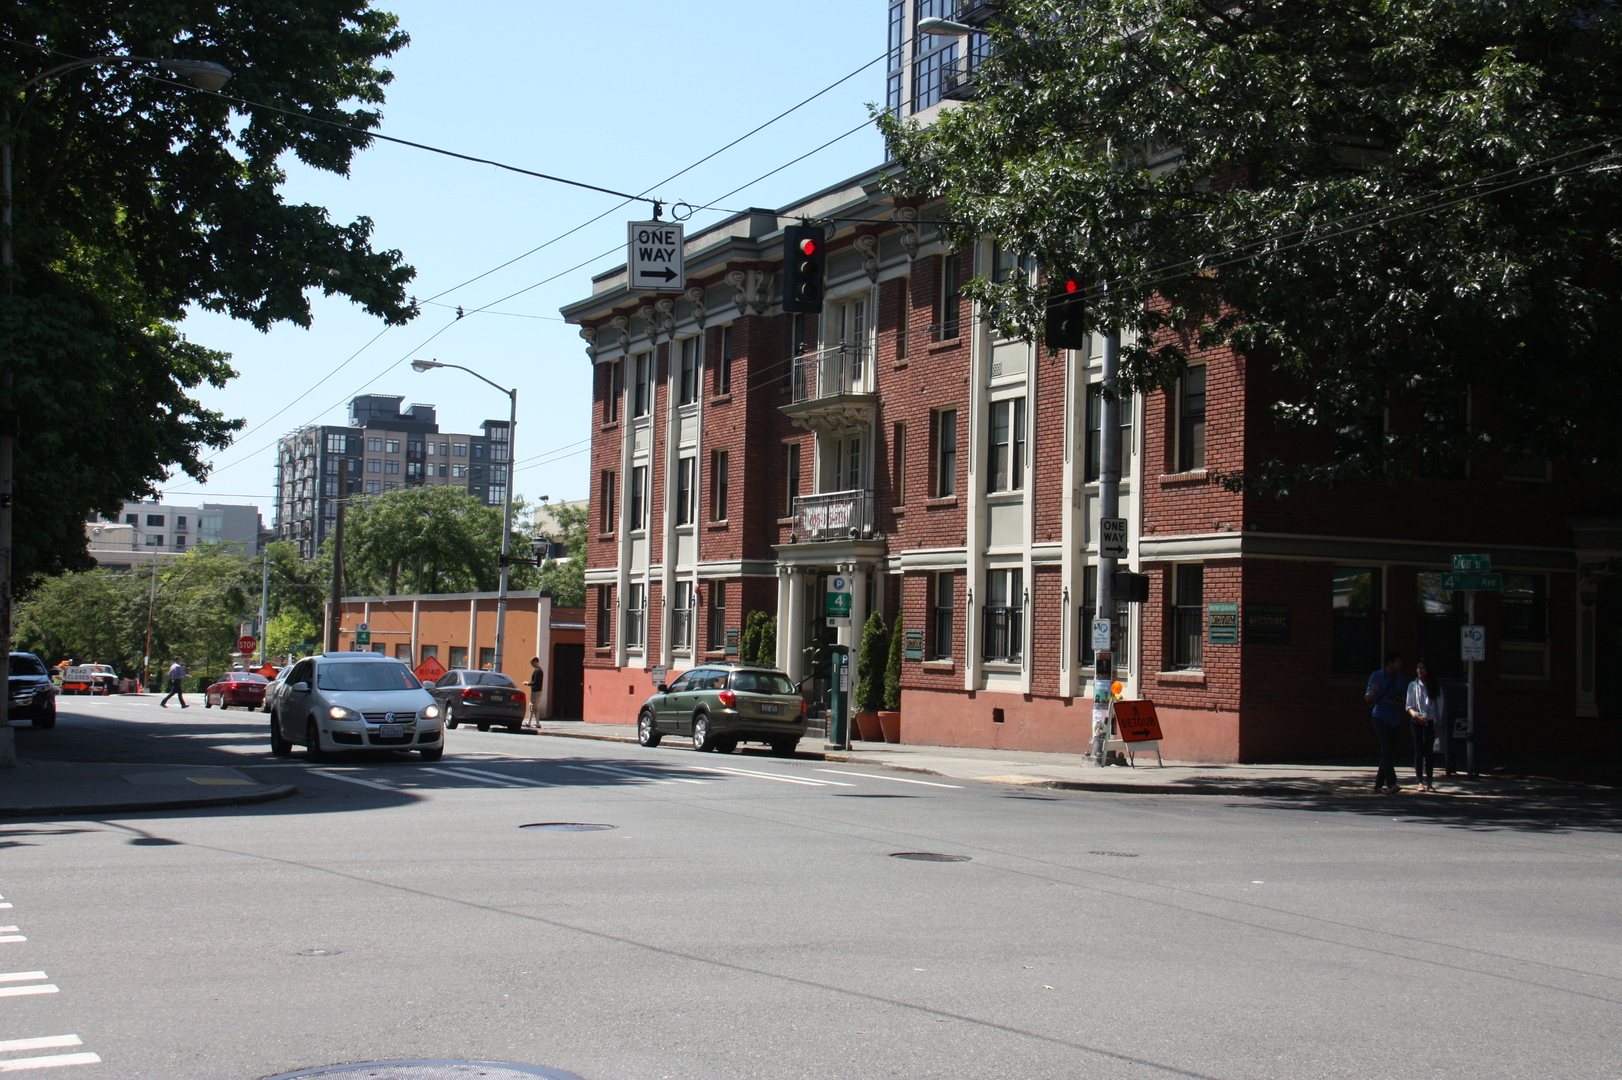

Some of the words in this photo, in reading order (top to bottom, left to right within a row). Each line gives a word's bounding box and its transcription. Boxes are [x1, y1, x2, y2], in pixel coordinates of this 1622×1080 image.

[638, 230, 675, 245] ONE
[638, 248, 676, 262] WAY
[1104, 520, 1124, 531] ONE
[1104, 532, 1125, 542] WAY
[1481, 578, 1496, 586] Ave
[834, 595, 843, 606] 4
[1122, 717, 1156, 728] DETOUR
